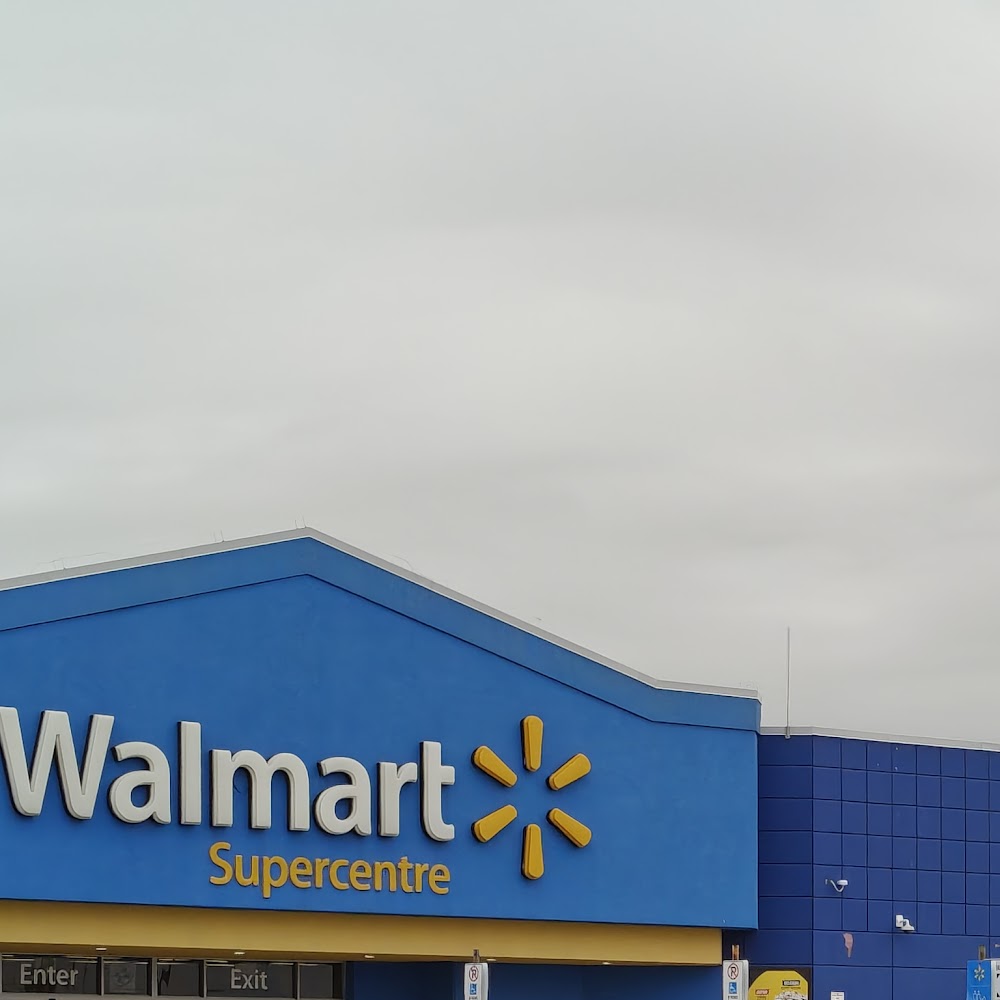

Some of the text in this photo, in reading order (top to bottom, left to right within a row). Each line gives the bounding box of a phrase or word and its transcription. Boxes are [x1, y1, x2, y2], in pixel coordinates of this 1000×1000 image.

[0, 706, 456, 842] Walmart
[208, 841, 451, 898] Supercentre
[20, 963, 79, 986] Enter
[230, 968, 268, 990] Exit
